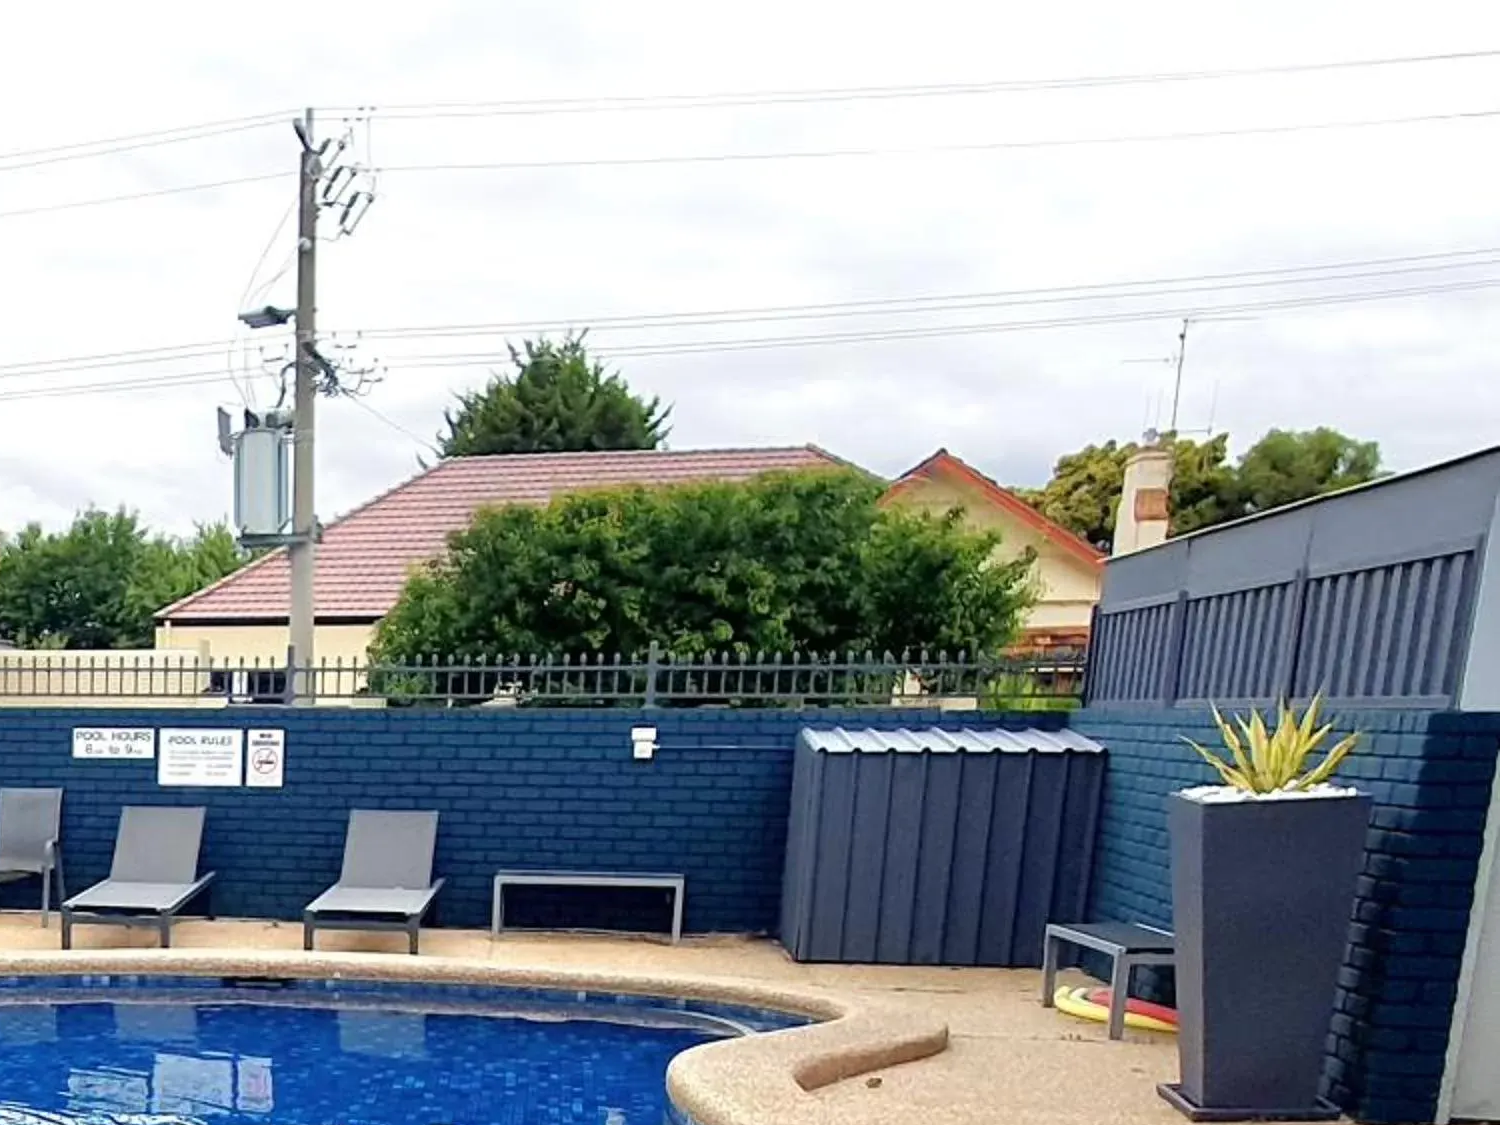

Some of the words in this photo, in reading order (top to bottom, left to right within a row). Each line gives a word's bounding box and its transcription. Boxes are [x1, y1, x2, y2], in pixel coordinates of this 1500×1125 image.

[76, 731, 107, 741] POOL
[111, 731, 151, 742] HOURS
[168, 735, 197, 745] POOL
[201, 735, 232, 746] RULES
